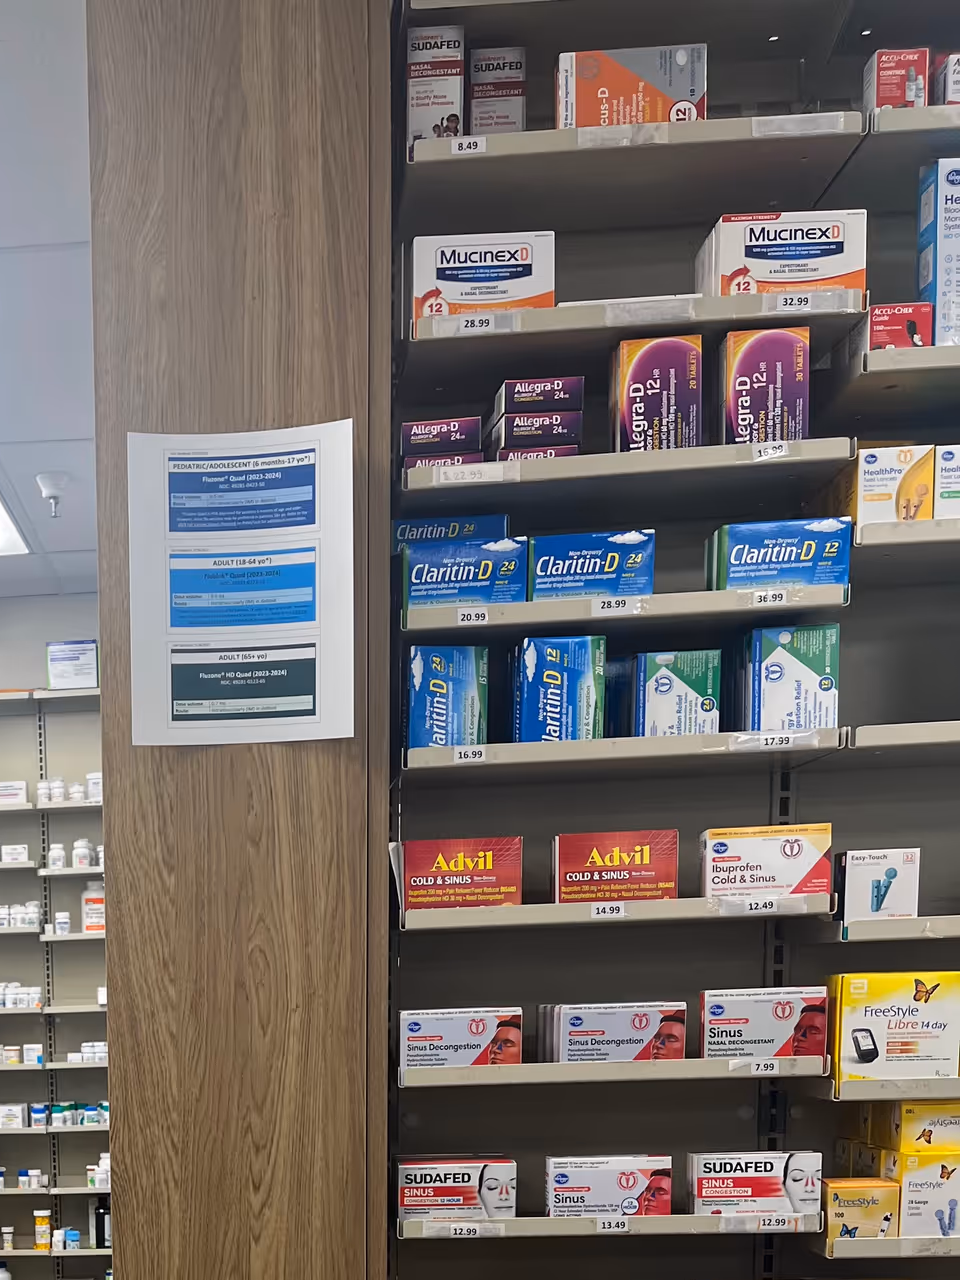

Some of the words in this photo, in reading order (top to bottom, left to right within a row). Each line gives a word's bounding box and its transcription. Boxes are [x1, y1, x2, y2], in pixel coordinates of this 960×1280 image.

[410, 40, 460, 52] SUDAFED
[474, 62, 522, 72] SUDAFED
[458, 142, 478, 151] 8.49
[736, 281, 750, 292] 12
[782, 297, 808, 306] 32.99
[428, 303, 442, 313] 12
[464, 319, 490, 328] 28.99
[752, 373, 766, 389] 12
[760, 362, 767, 372] HR
[796, 373, 803, 381] 30
[646, 379, 660, 395] 12
[653, 368, 660, 378] HR
[690, 380, 696, 389] 20
[514, 380, 563, 394] Allegra-D
[514, 415, 560, 428] Allegra-D
[411, 422, 459, 434] Allegra-D
[758, 445, 784, 458] 16.99
[173, 462, 251, 470] PEDIATRIC/ADOLESCENT
[252, 460, 260, 468] (6
[261, 456, 296, 466] months-17
[247, 472, 282, 481] (2023-2024)
[864, 468, 902, 476] HealthPro
[397, 523, 459, 540] Claritin-D
[730, 541, 816, 564] Claritin-D
[825, 543, 839, 552] 12
[236, 558, 256, 566] (18-64
[536, 553, 620, 576] Claritin-D
[628, 554, 642, 563] 24
[230, 570, 246, 578] Quad
[411, 560, 492, 583] Claritin-D
[500, 561, 515, 571] 24
[757, 593, 783, 603] 36.99
[600, 600, 626, 609] 28.99
[460, 612, 486, 622] 20.99
[546, 648, 556, 662] 12
[432, 656, 440, 670] 24
[253, 669, 287, 677] (2023-2024)
[596, 667, 603, 675] 20
[764, 737, 790, 746] 17.99
[458, 751, 483, 759] 16.99
[430, 850, 493, 872] Advil
[584, 845, 650, 867] Advil
[712, 863, 762, 873] Ibuprofen
[411, 877, 434, 886] COLD
[436, 876, 443, 884] &
[444, 876, 472, 884] SINUS
[566, 872, 591, 881] COLD
[593, 872, 599, 880] &
[602, 871, 629, 880] SINUS
[712, 875, 736, 884] Cold
[739, 875, 747, 883] &
[749, 874, 776, 883] Sinus
[596, 906, 620, 915] 14.99
[748, 901, 774, 910] 12.49
[864, 1005, 919, 1019] FreeStyle
[887, 1020, 918, 1029] Libre
[931, 1021, 948, 1031] day
[708, 1027, 743, 1038] Sinus
[429, 1042, 481, 1052] Decongestion
[590, 1038, 644, 1047] Decongestion
[755, 1063, 774, 1071] 7.99
[703, 1161, 774, 1174] SUDAFED
[405, 1173, 471, 1184] SUDAFED
[702, 1179, 734, 1188] SINUS
[908, 1181, 944, 1190] FreeStyle
[404, 1188, 434, 1196] SINUS
[554, 1194, 585, 1204] Sinus
[838, 1197, 879, 1208] FreeStyle
[762, 1218, 786, 1226] 12.99
